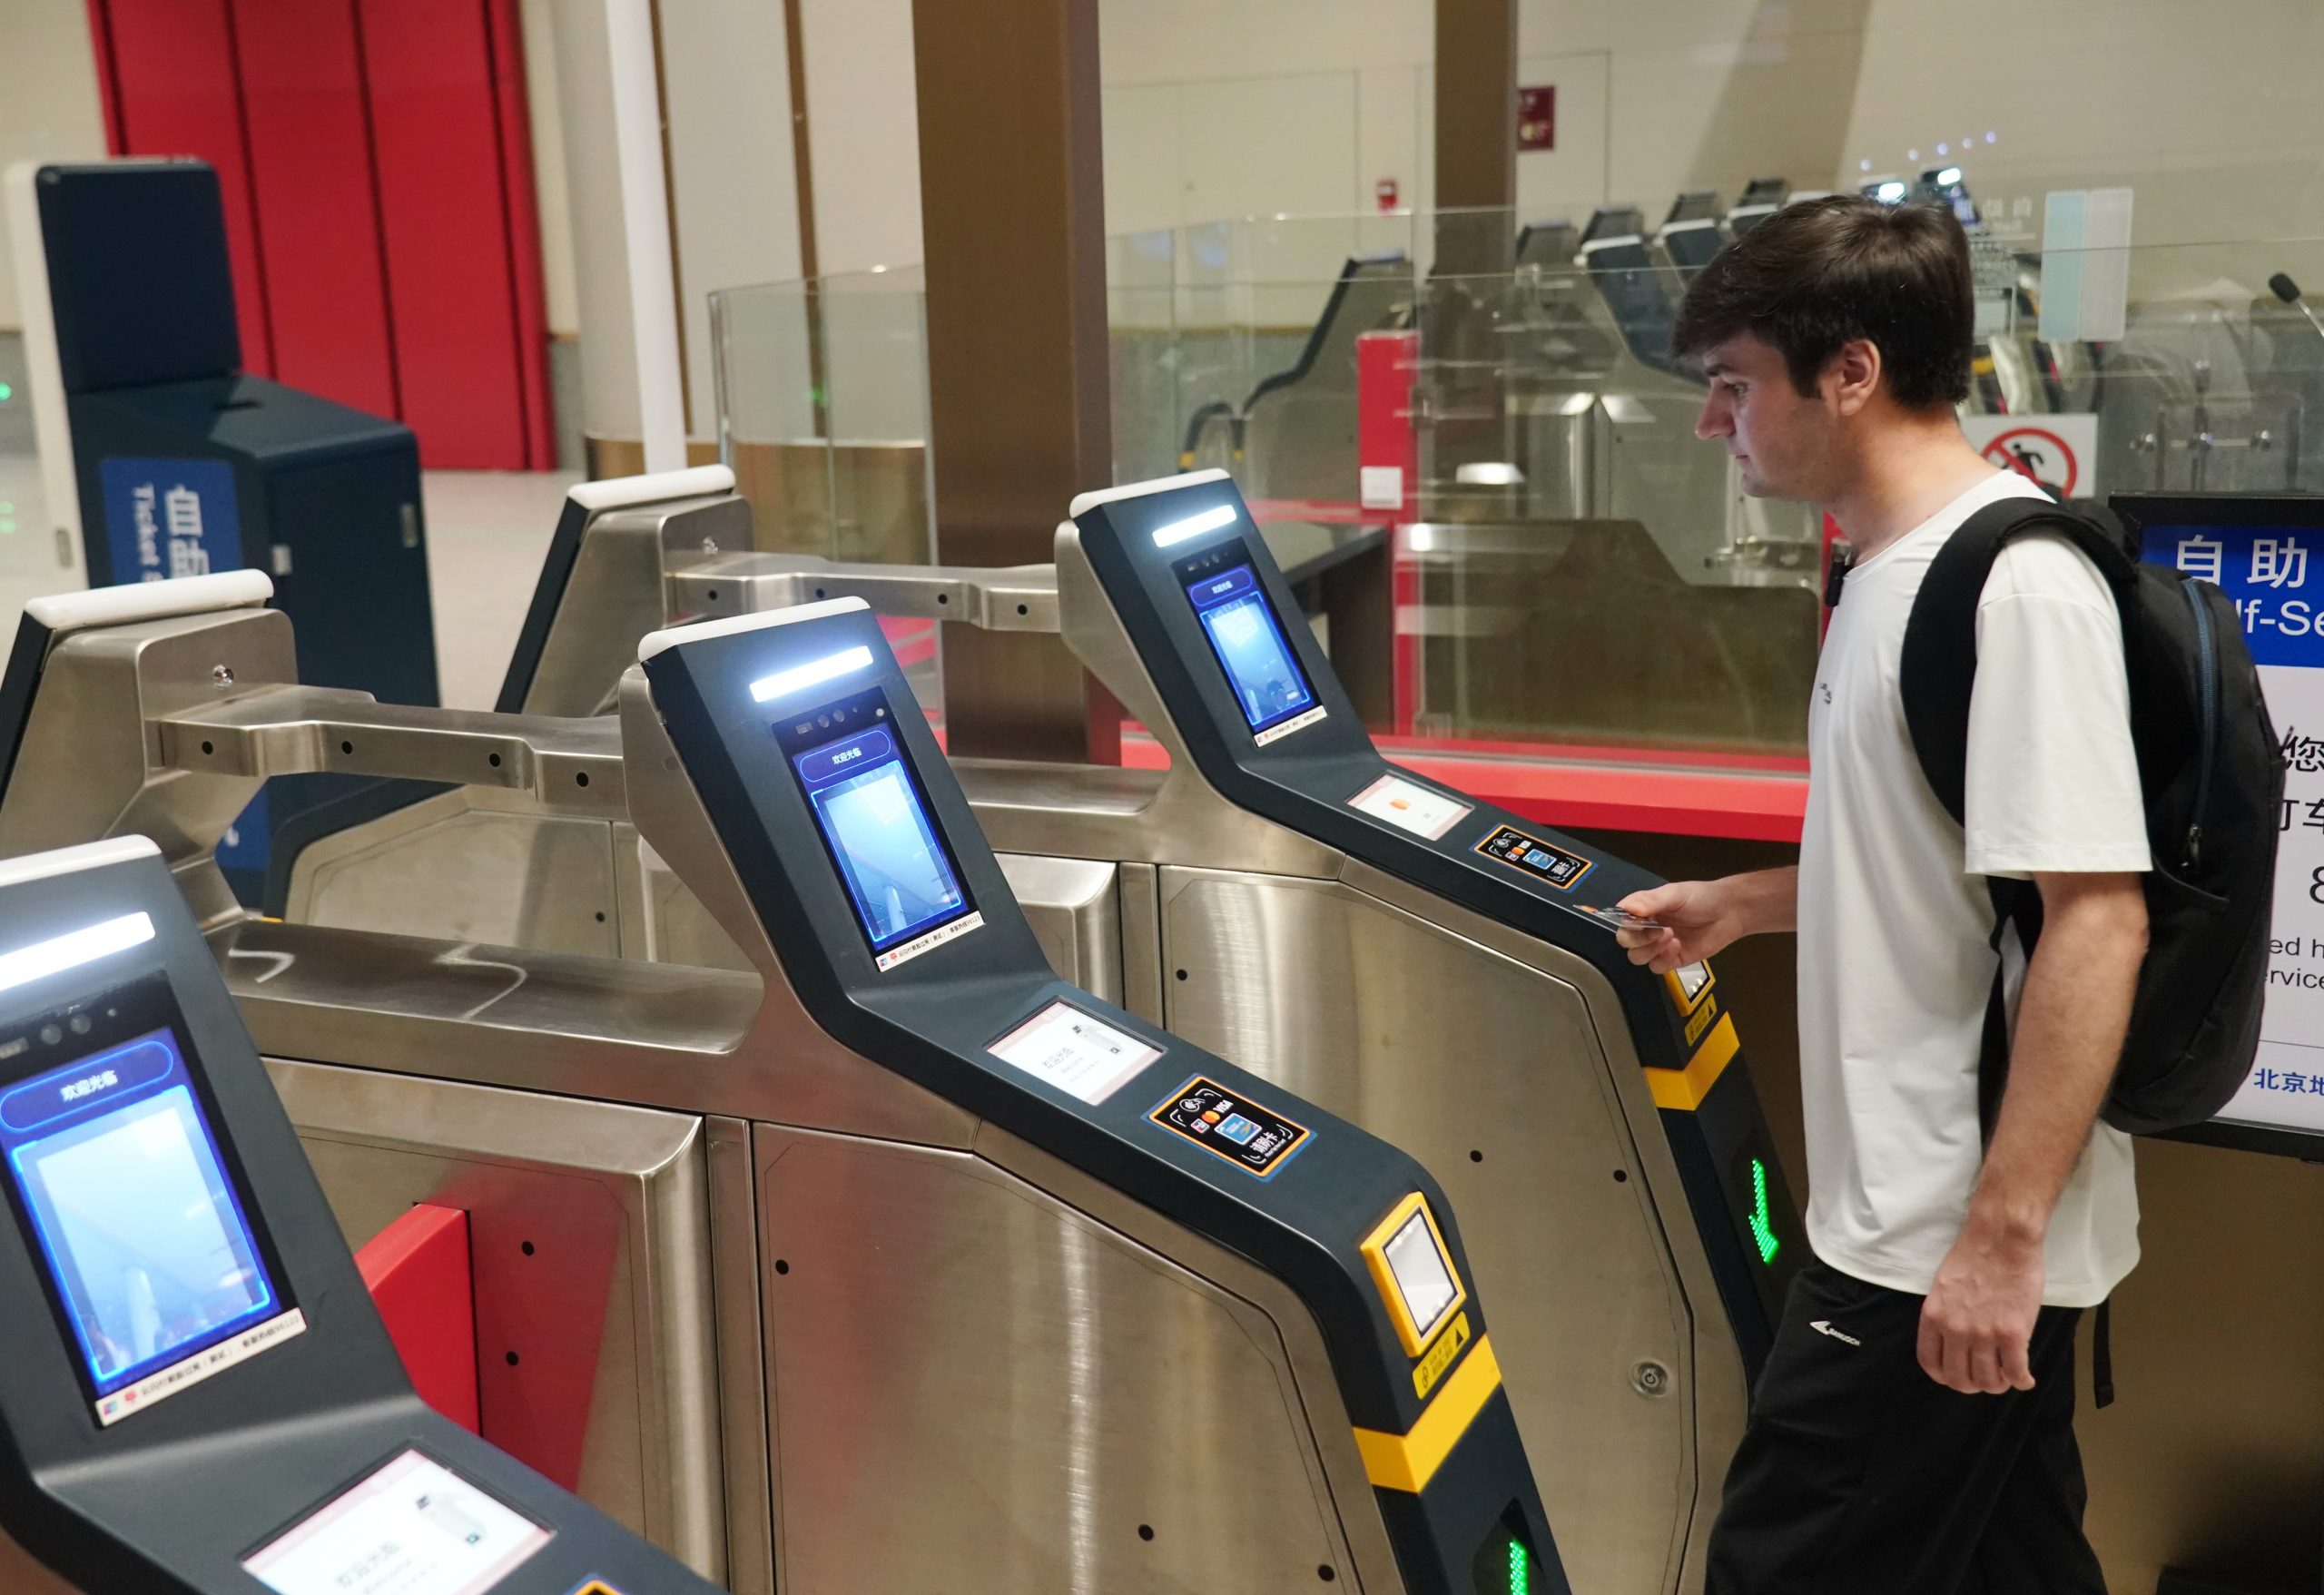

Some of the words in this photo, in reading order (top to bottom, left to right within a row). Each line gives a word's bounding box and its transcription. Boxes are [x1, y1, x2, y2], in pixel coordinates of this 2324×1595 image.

[2177, 534, 2308, 588] 自助
[2270, 937, 2300, 957] ed
[1212, 1099, 1234, 1114] VISA
